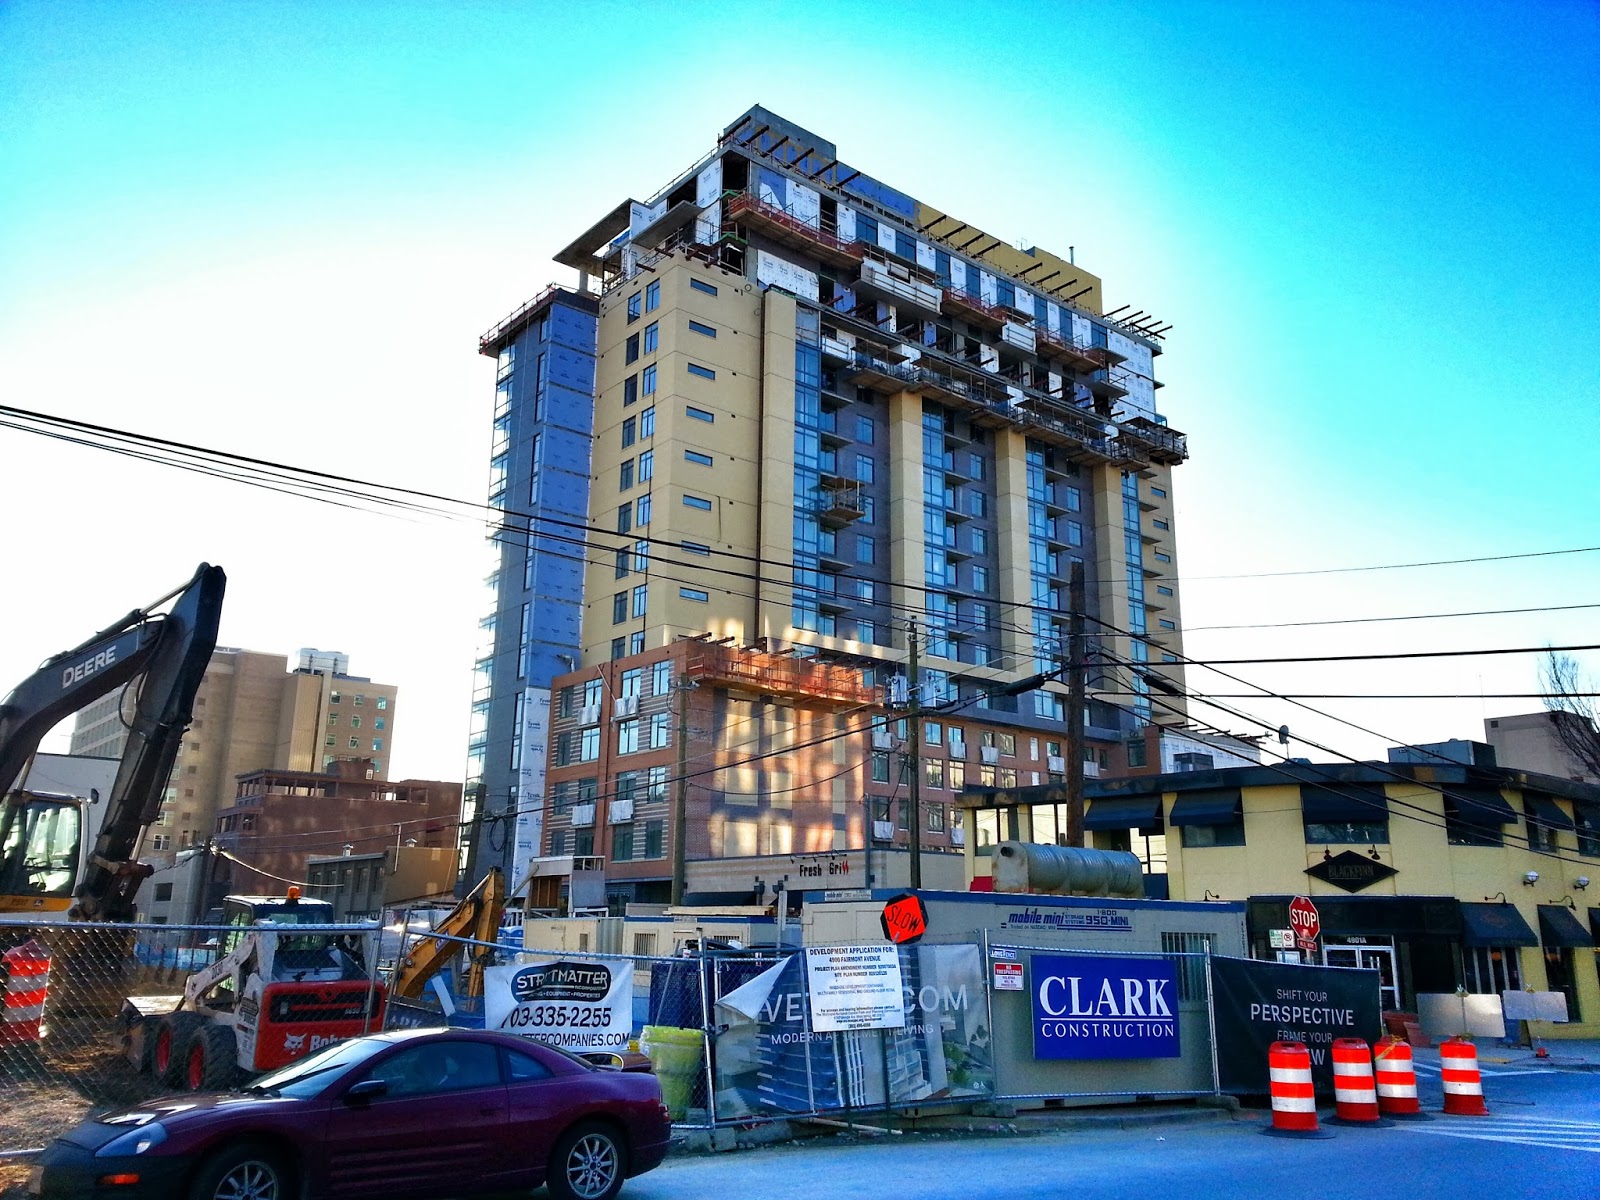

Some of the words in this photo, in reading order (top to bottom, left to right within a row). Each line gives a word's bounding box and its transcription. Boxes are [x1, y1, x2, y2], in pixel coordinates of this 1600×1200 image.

[63, 645, 116, 689] DEERE
[800, 864, 822, 876] Fresh
[888, 906, 920, 933] SLOW
[1008, 908, 1042, 923] mobile
[1043, 912, 1065, 924] mini
[1292, 909, 1316, 927] STOP
[517, 969, 608, 989] STRTMATTER
[1040, 976, 1172, 1016] CLARK
[1277, 989, 1302, 1000] SHIFT
[1304, 991, 1328, 1002] YOUR
[1251, 1004, 1354, 1025] PERSPECTIVE
[771, 1030, 822, 1044] MODERN
[1042, 1023, 1174, 1037] CONSTRUCTION
[1277, 1030, 1307, 1042] FRAME
[1309, 1032, 1333, 1042] YOUR
[522, 1033, 630, 1047] RCOMPANIES.COM
